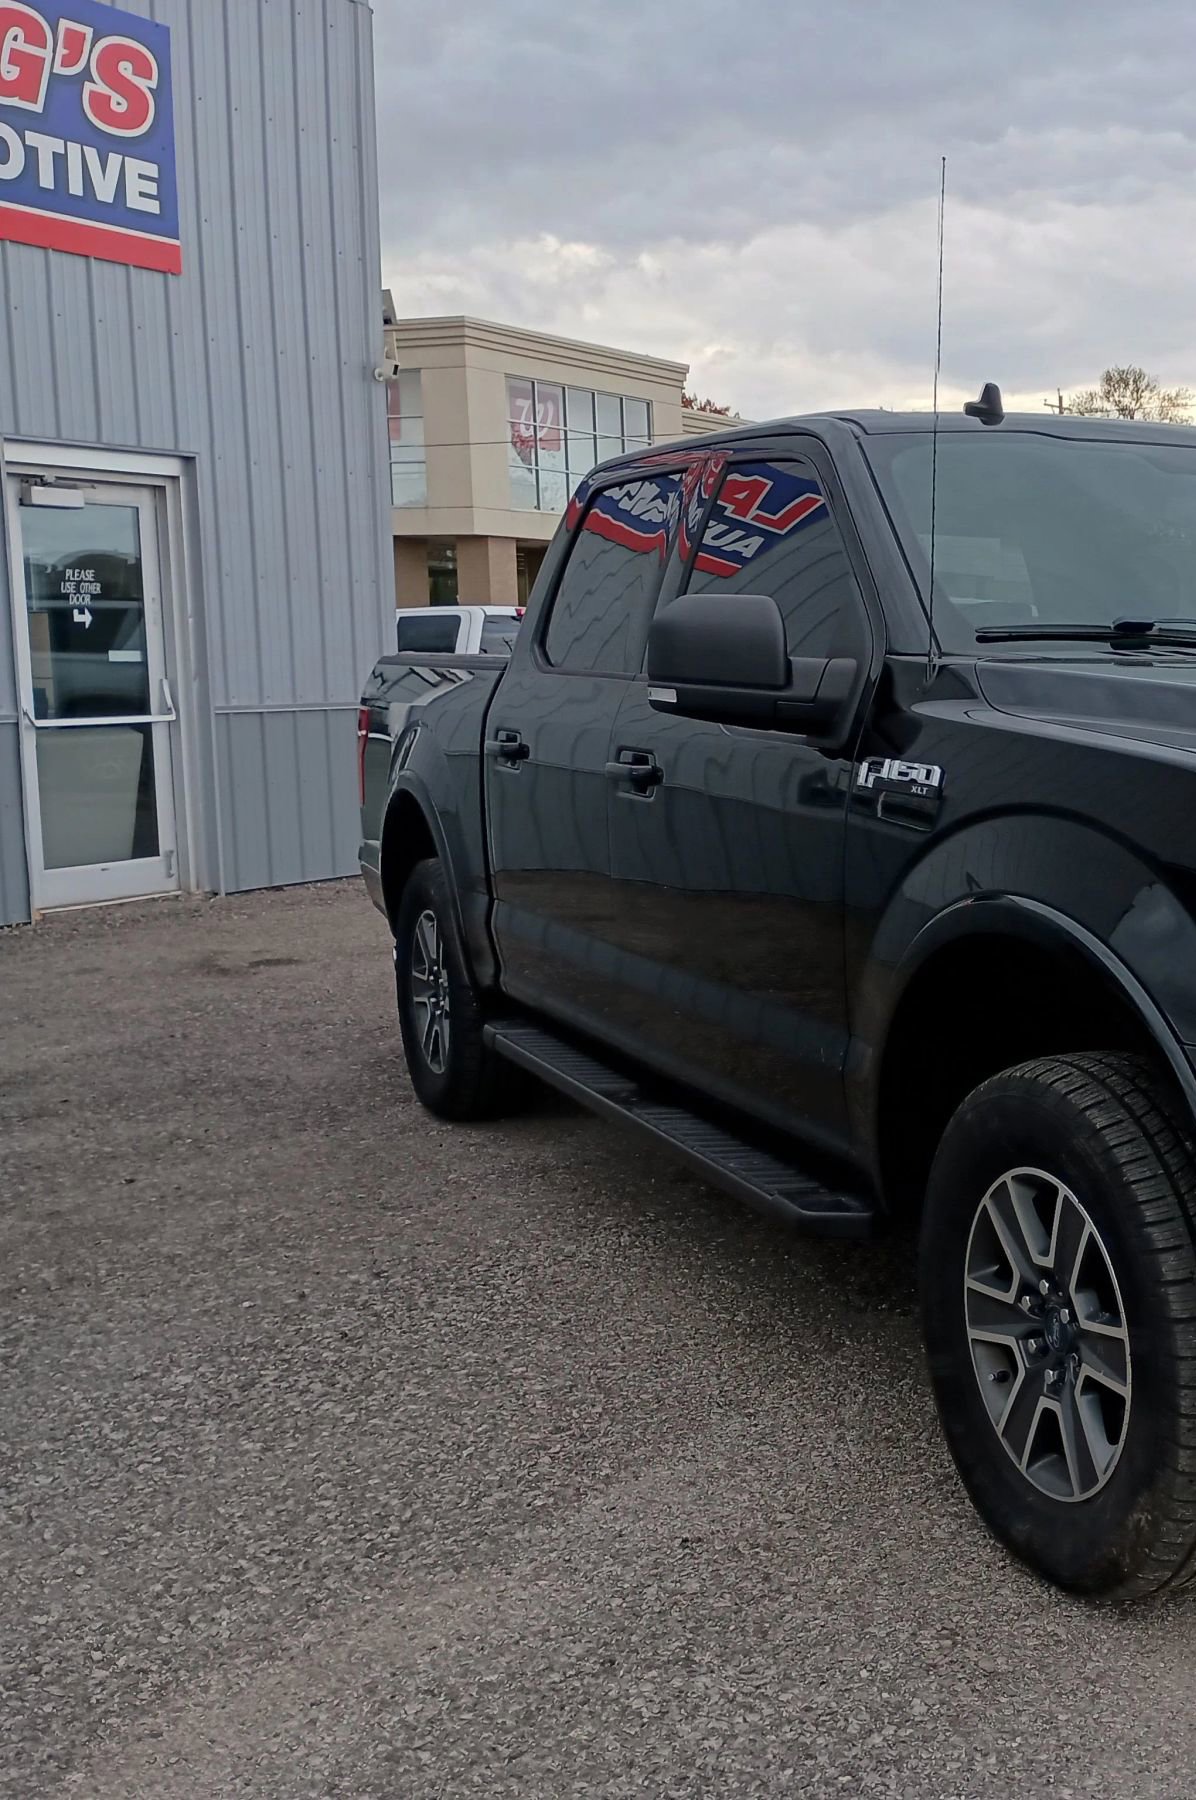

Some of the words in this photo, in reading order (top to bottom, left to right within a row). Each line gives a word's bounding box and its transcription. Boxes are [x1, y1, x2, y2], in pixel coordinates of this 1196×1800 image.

[65, 568, 96, 581] PLEASE
[60, 581, 77, 593] USE
[79, 582, 102, 594] OTHER
[69, 593, 91, 605] DOOR
[910, 785, 929, 795] XLT
